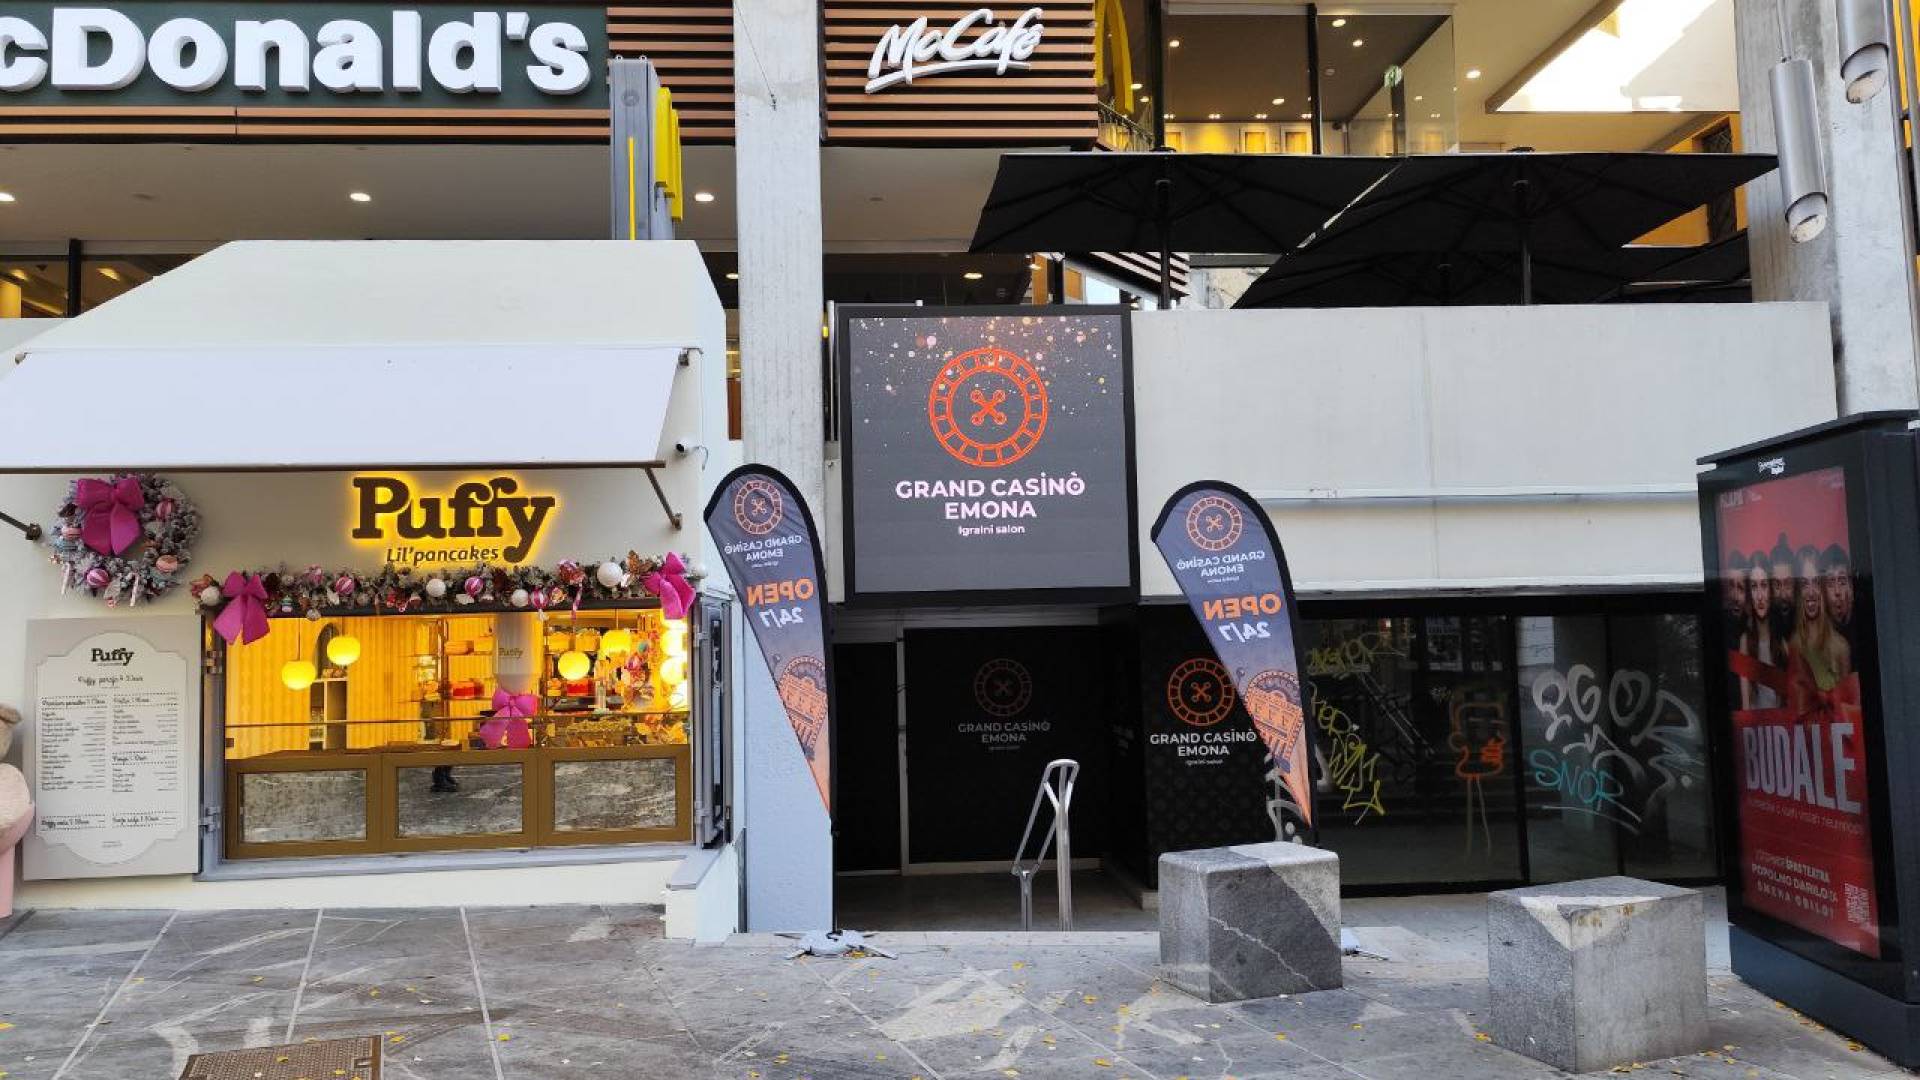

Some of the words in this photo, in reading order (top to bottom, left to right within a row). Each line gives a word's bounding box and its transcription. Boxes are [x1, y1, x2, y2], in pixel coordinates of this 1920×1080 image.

[895, 478, 985, 499] GRAND
[945, 500, 1037, 520] EMONA
[352, 476, 556, 563] Puffy
[996, 524, 1025, 534] salon
[91, 647, 134, 666] Puffy
[957, 722, 1002, 733] GRAND
[981, 733, 1027, 743] EMONA
[1149, 733, 1201, 745] GRAND
[1177, 745, 1230, 757] EMONA
[1742, 722, 1861, 814] BUDALE
